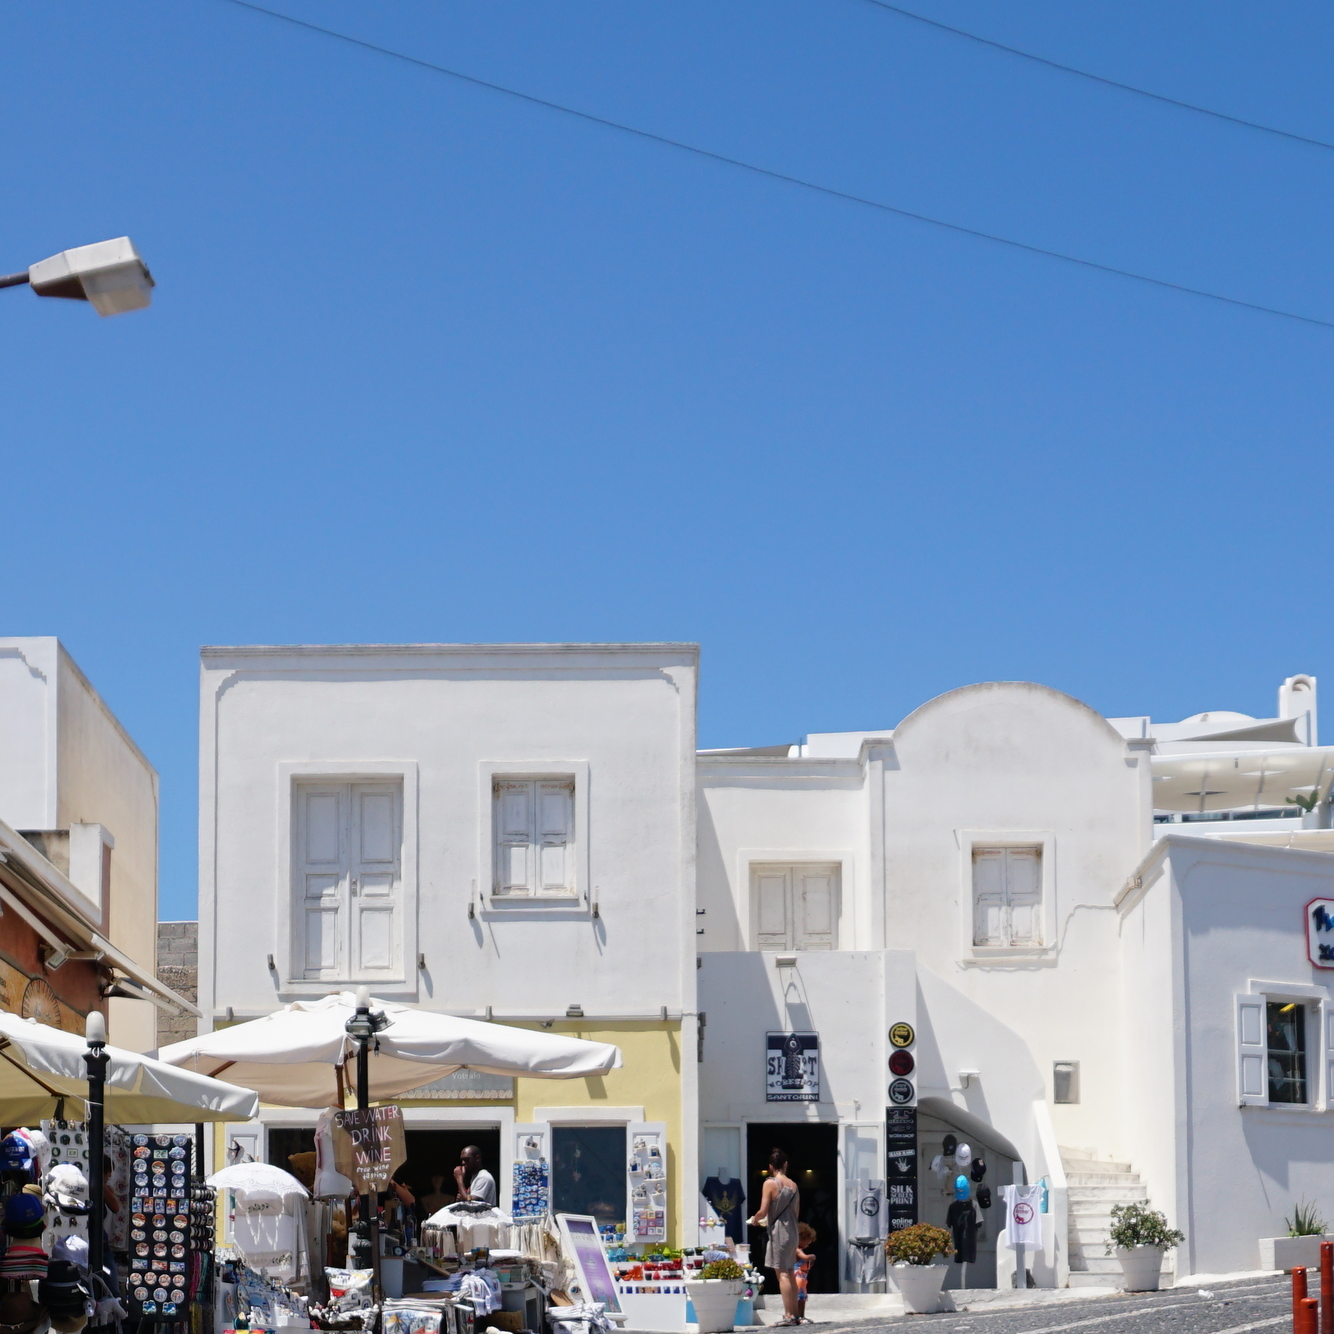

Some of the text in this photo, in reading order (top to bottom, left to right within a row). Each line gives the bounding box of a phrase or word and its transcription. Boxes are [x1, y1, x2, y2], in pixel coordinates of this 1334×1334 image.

[335, 1105, 400, 1128] SAVE WATER
[890, 1185, 913, 1193] SILK
[891, 1217, 914, 1225] online
